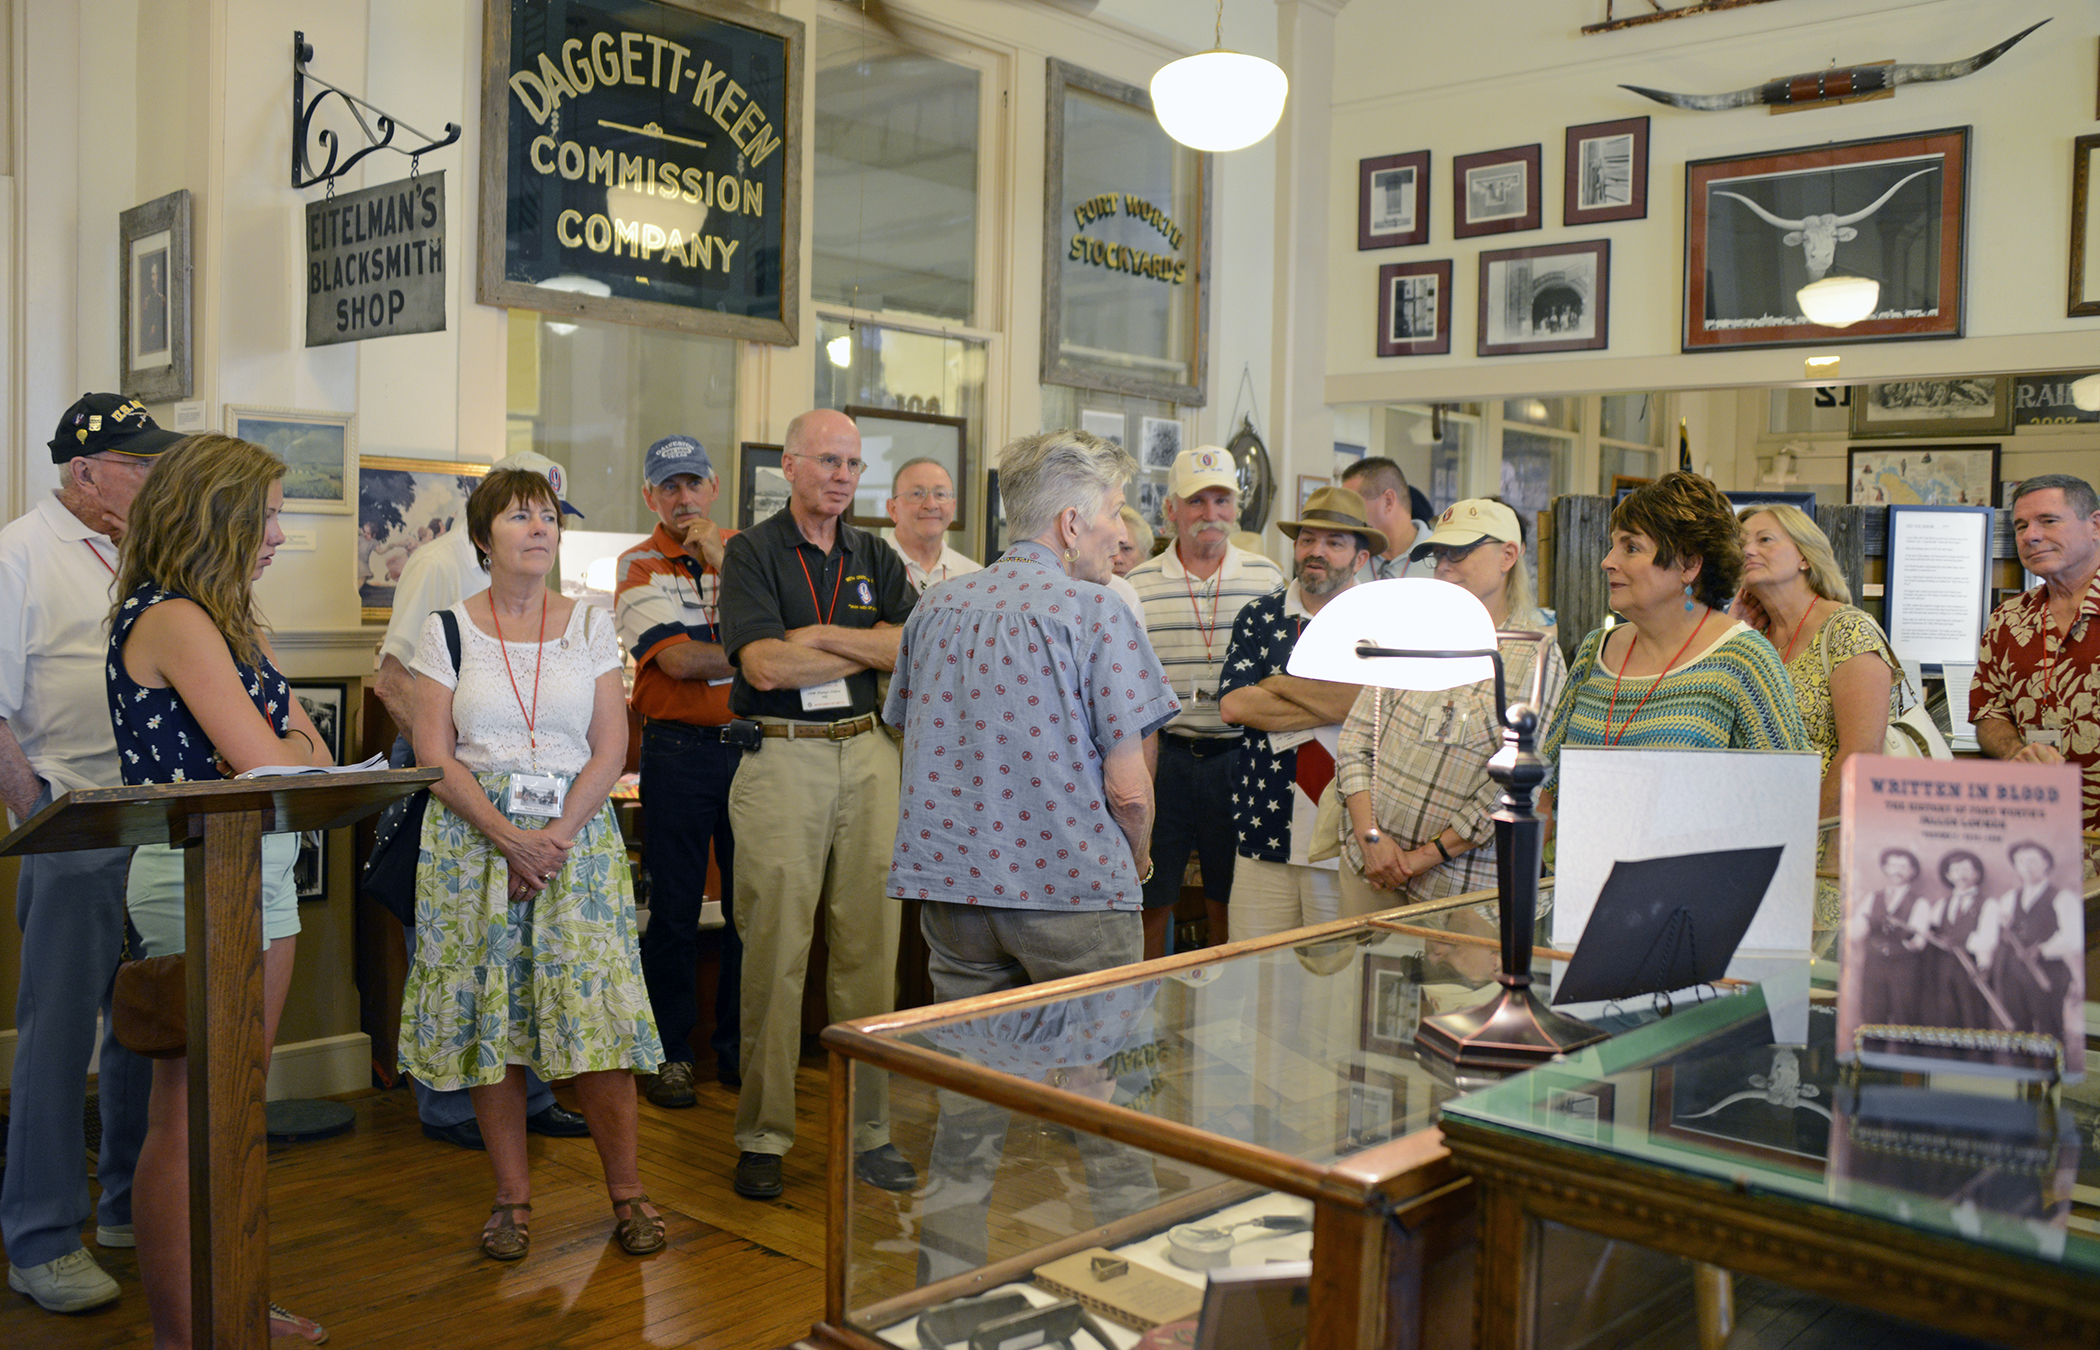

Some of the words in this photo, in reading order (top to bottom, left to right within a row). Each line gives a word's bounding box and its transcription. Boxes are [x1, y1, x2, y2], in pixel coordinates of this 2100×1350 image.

[508, 31, 781, 168] DAGGETT-KEEN
[530, 135, 763, 217] COMMISSION
[310, 183, 438, 253] EITELMAN'S
[556, 208, 739, 273] COMPANY
[1073, 191, 1119, 231] FORT
[1124, 193, 1185, 251] WORTH
[310, 237, 442, 295] BLACKSMITH
[1068, 232, 1187, 285] STOCKYARDS
[336, 289, 405, 333] SHOP
[1869, 776, 1962, 798] WRITTEN
[1967, 783, 1989, 799] IN
[1995, 784, 2060, 804] BLOOD
